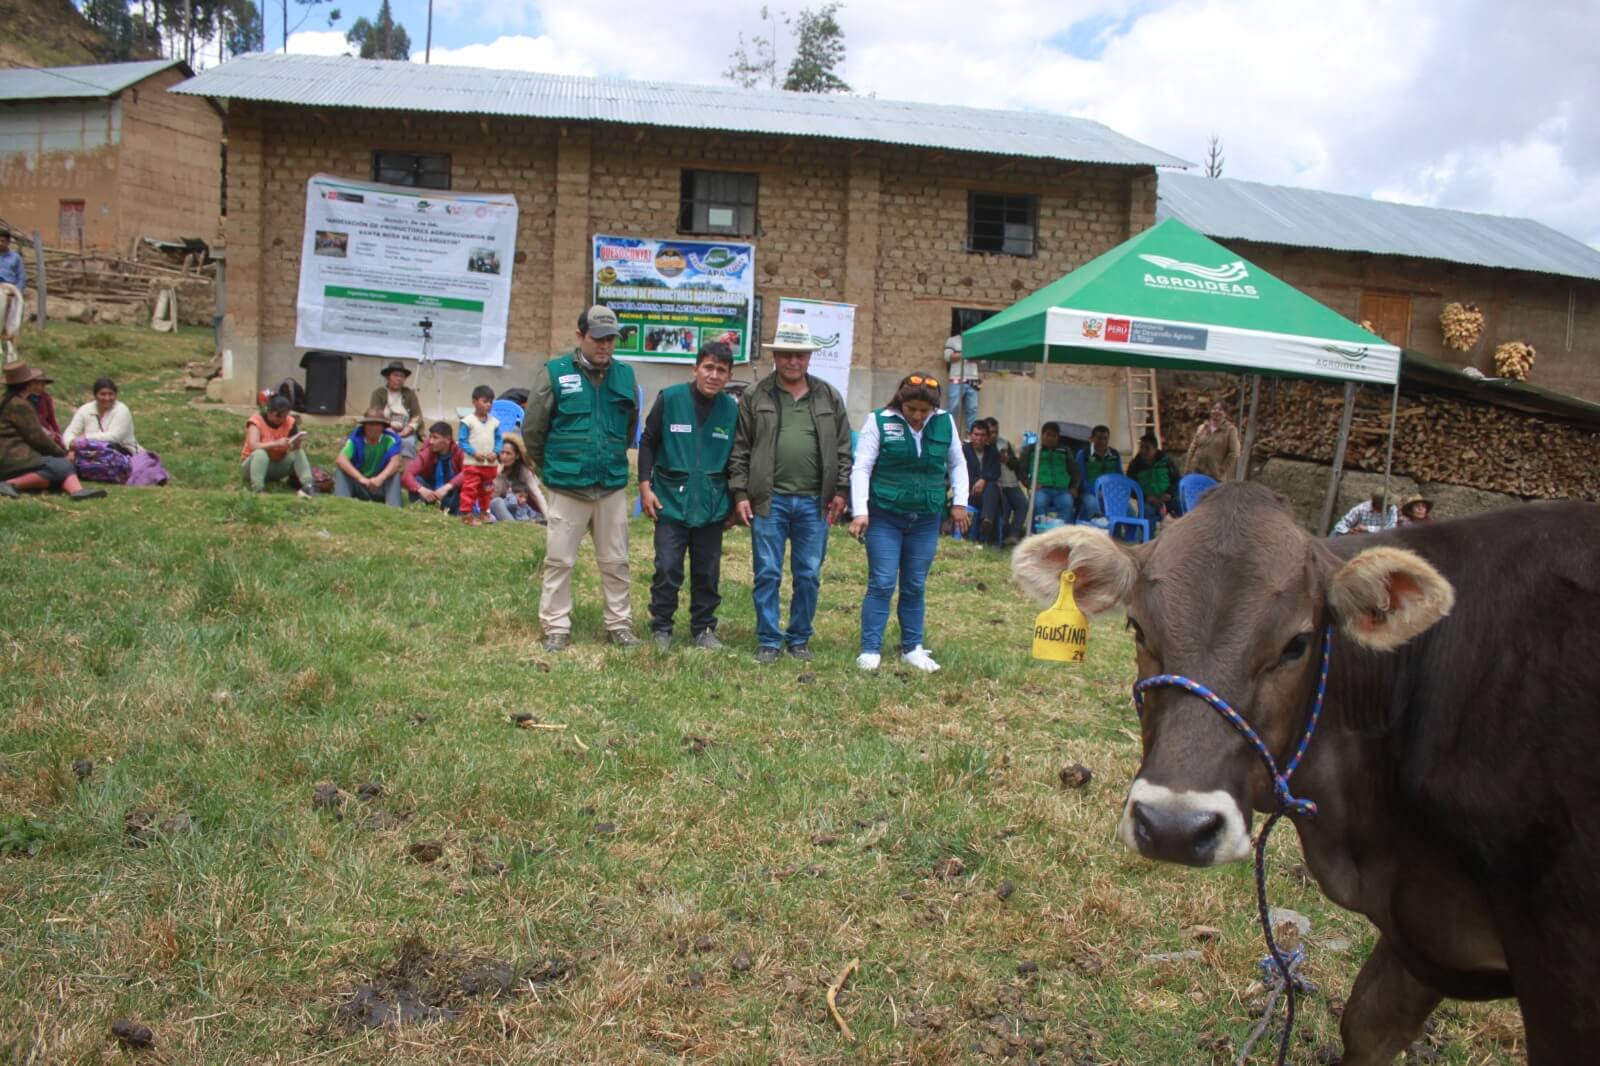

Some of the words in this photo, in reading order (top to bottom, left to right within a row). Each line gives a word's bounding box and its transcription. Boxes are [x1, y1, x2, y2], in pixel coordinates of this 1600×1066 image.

[1144, 273, 1257, 295] AGROIDEAS
[1142, 330, 1172, 338] Desarrollo
[1173, 333, 1195, 341] Agrario
